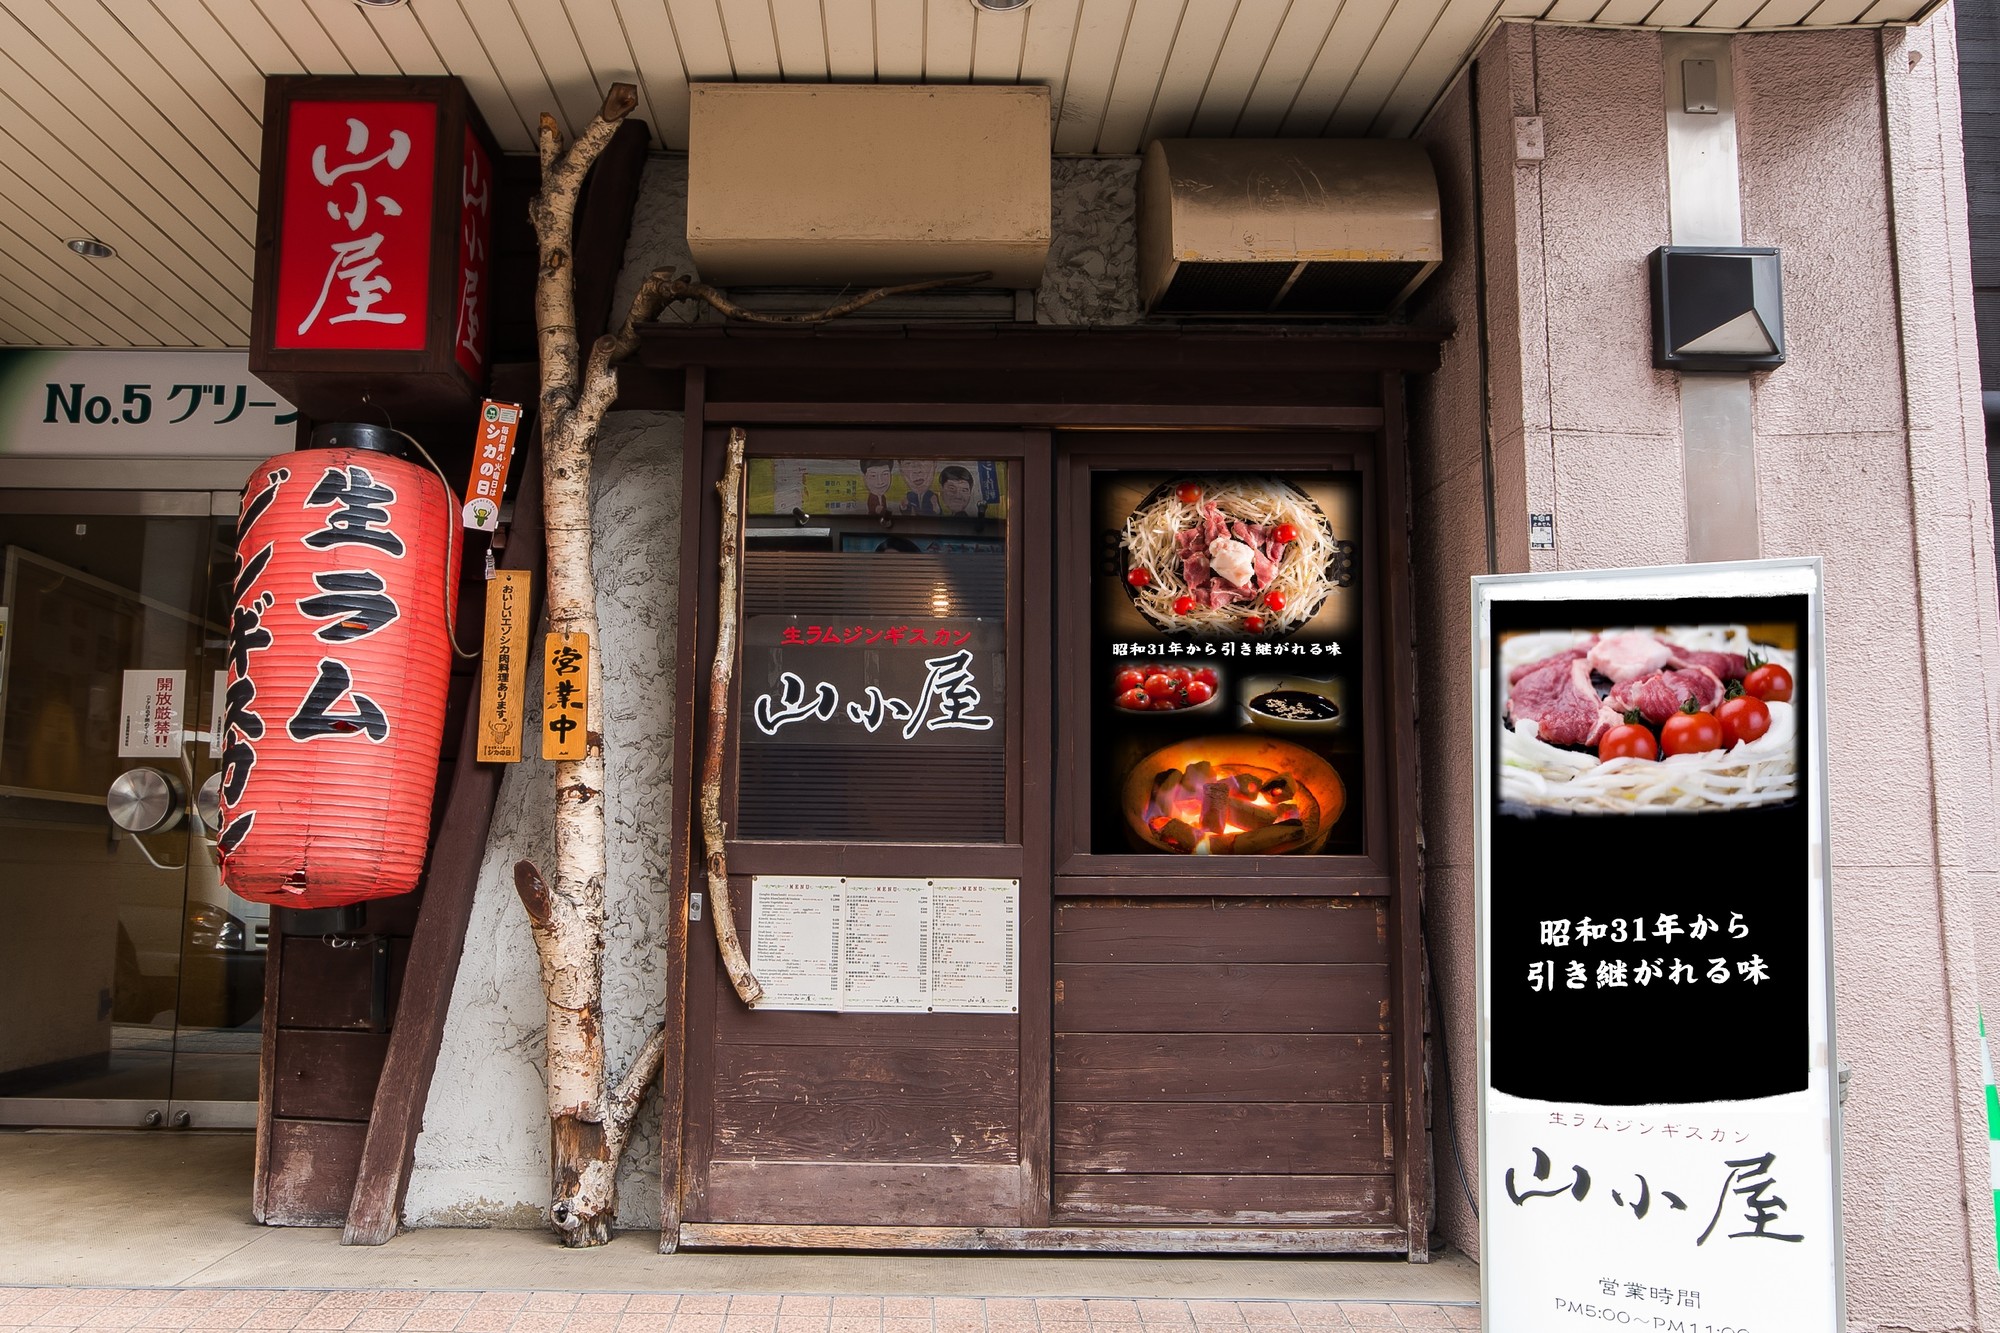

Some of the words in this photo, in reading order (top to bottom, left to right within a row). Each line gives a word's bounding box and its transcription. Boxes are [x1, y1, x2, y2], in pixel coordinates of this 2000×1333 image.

[298, 118, 411, 336] 山小屋
[43, 383, 151, 425] No.5
[477, 424, 500, 496] シカの日
[287, 465, 405, 743] 生ラム
[781, 625, 971, 646] 生ラムジンギスカン
[496, 584, 513, 723] おいしいエゾシカ肉料理あります。
[1112, 641, 1342, 656] 昭和31年から引き継がれる味
[154, 677, 173, 748] 開放厳禁!!
[547, 646, 583, 744] 営業中
[754, 649, 993, 739] 山小屋
[1540, 911, 1749, 947] 昭和31年から
[1527, 954, 1770, 992] 引き継がれる味
[1549, 1112, 1749, 1143] 生ラムジンギスカン
[1505, 1146, 1804, 1246] 山小屋
[1599, 1277, 1701, 1309] 営業時間
